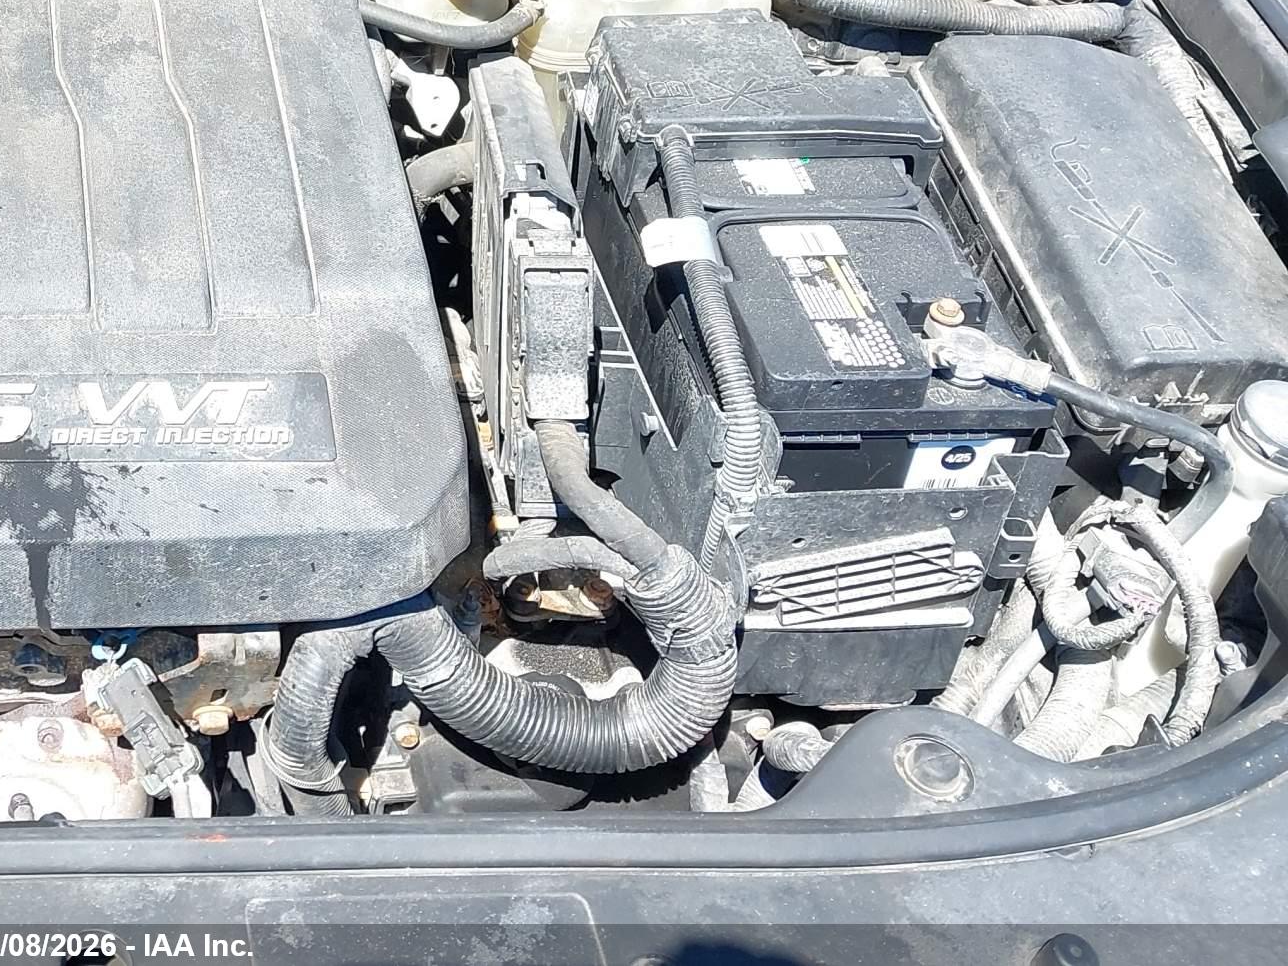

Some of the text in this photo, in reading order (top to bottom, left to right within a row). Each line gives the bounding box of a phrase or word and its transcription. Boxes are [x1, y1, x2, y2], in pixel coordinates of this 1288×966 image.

[76, 381, 271, 426] VVT
[50, 427, 294, 446] DIRECT INJECTION
[944, 452, 972, 464] 4/25
